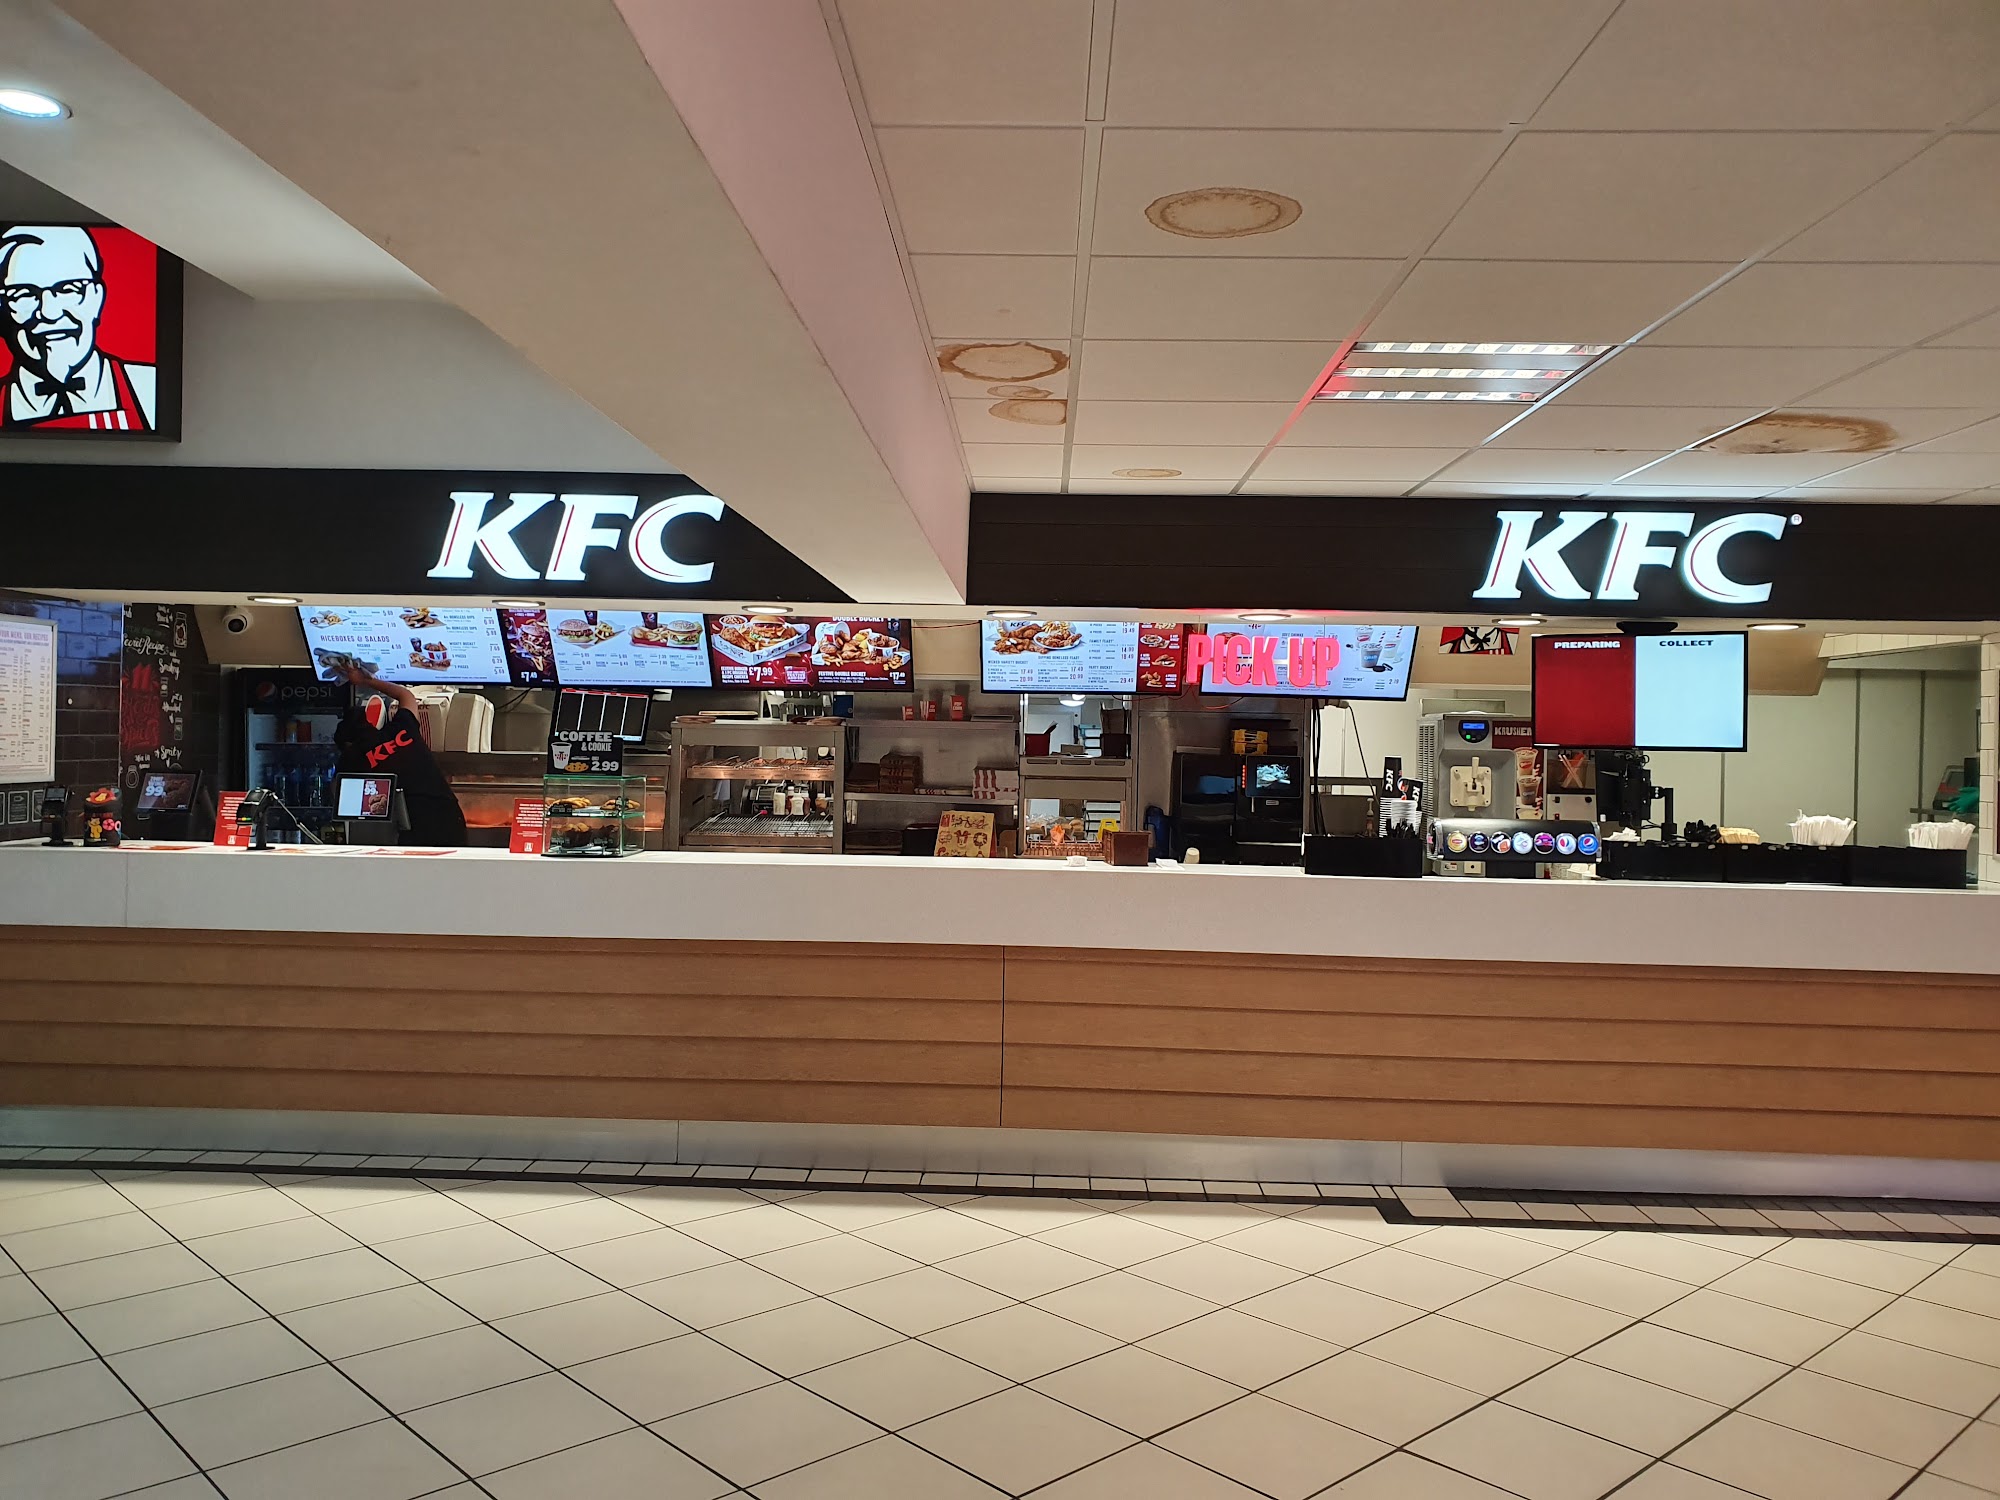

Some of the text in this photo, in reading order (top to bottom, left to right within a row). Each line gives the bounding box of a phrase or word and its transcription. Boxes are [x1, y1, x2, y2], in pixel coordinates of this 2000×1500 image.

[427, 492, 725, 583] KFC
[1472, 511, 1787, 604] KFC
[364, 635, 390, 643] SALADS
[1554, 640, 1620, 649] PREPARING
[1659, 639, 1714, 647] COLLECT
[1186, 634, 1341, 688] PICK UP
[749, 666, 773, 681] £7.99
[281, 684, 332, 701] pepsi
[560, 731, 612, 742] COFFEE
[365, 729, 413, 769] KFC
[581, 742, 612, 751] & COOKIE
[591, 761, 619, 771] 2.99
[1385, 769, 1394, 792] KFC
